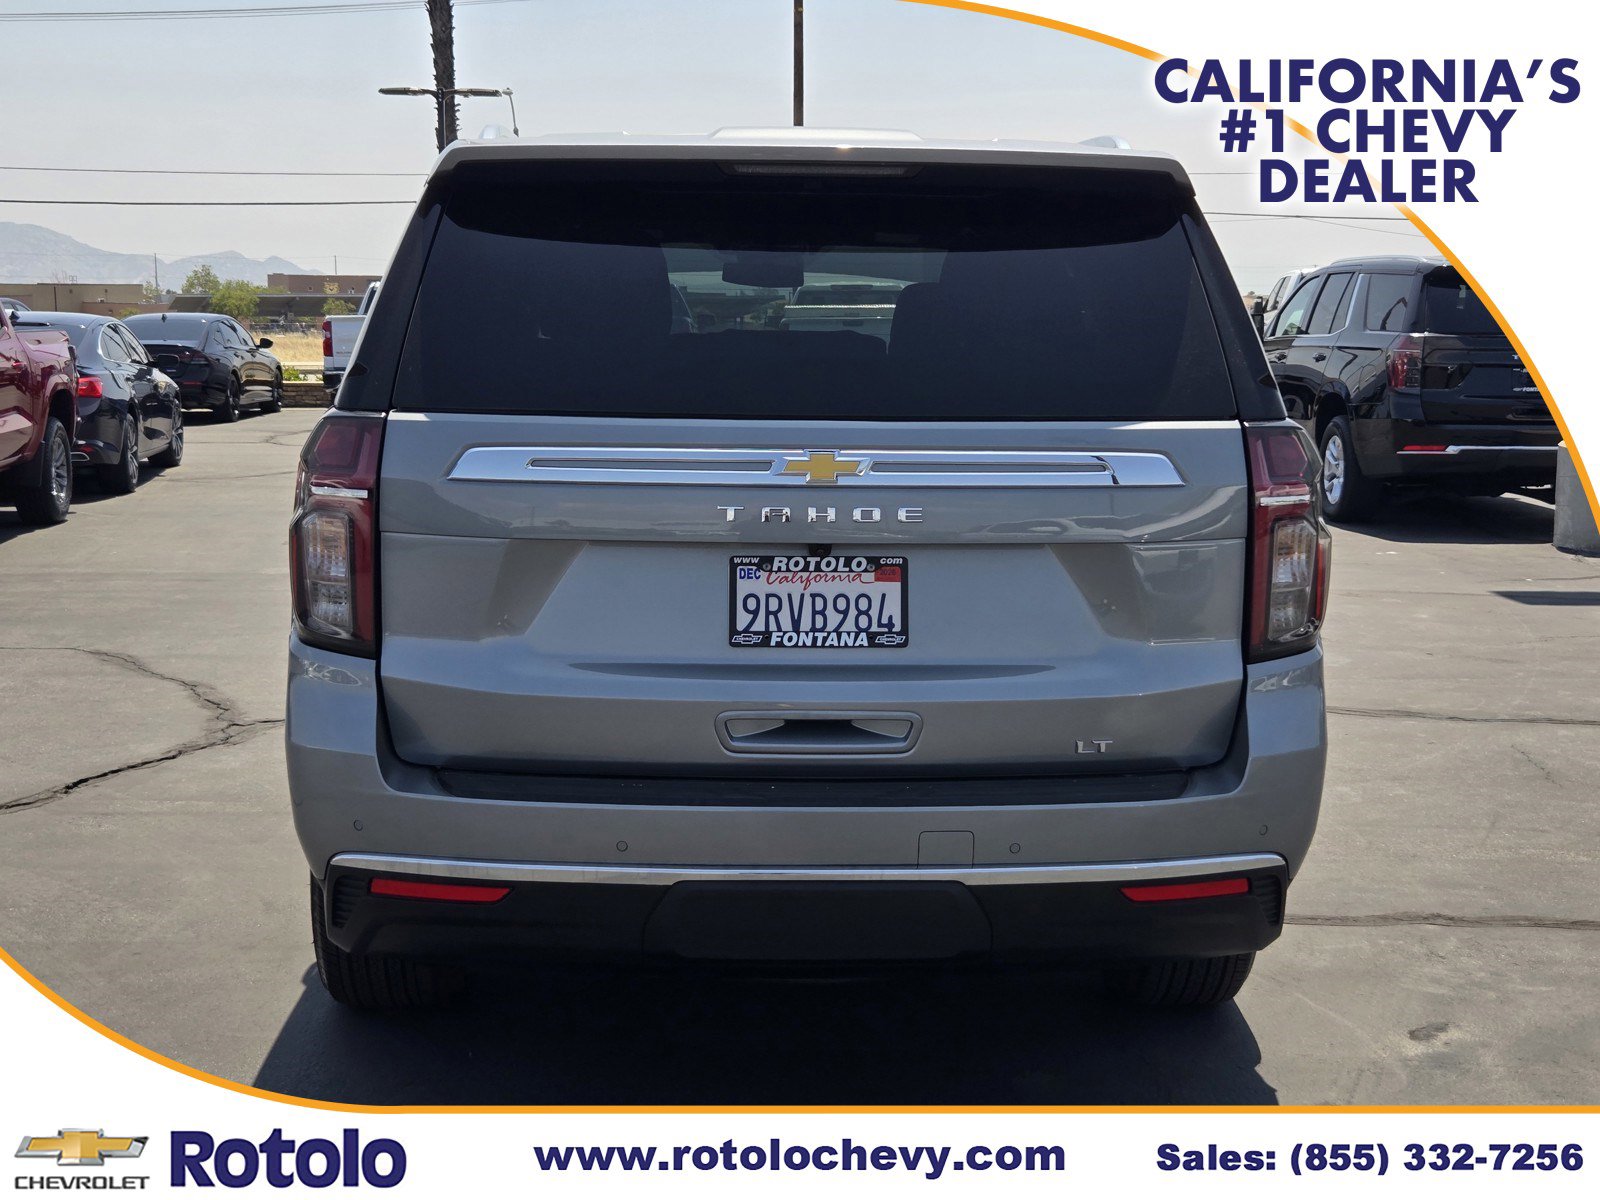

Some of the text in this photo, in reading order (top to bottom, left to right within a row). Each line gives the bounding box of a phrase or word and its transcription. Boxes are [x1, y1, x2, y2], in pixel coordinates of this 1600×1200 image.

[717, 506, 923, 522] TAHOE
[772, 556, 868, 572] ROTOLO
[739, 568, 761, 580] DEC
[766, 571, 875, 591] California
[742, 593, 896, 632] 9RVB984
[770, 632, 869, 647] FONTANA
[1075, 740, 1113, 753] LT
